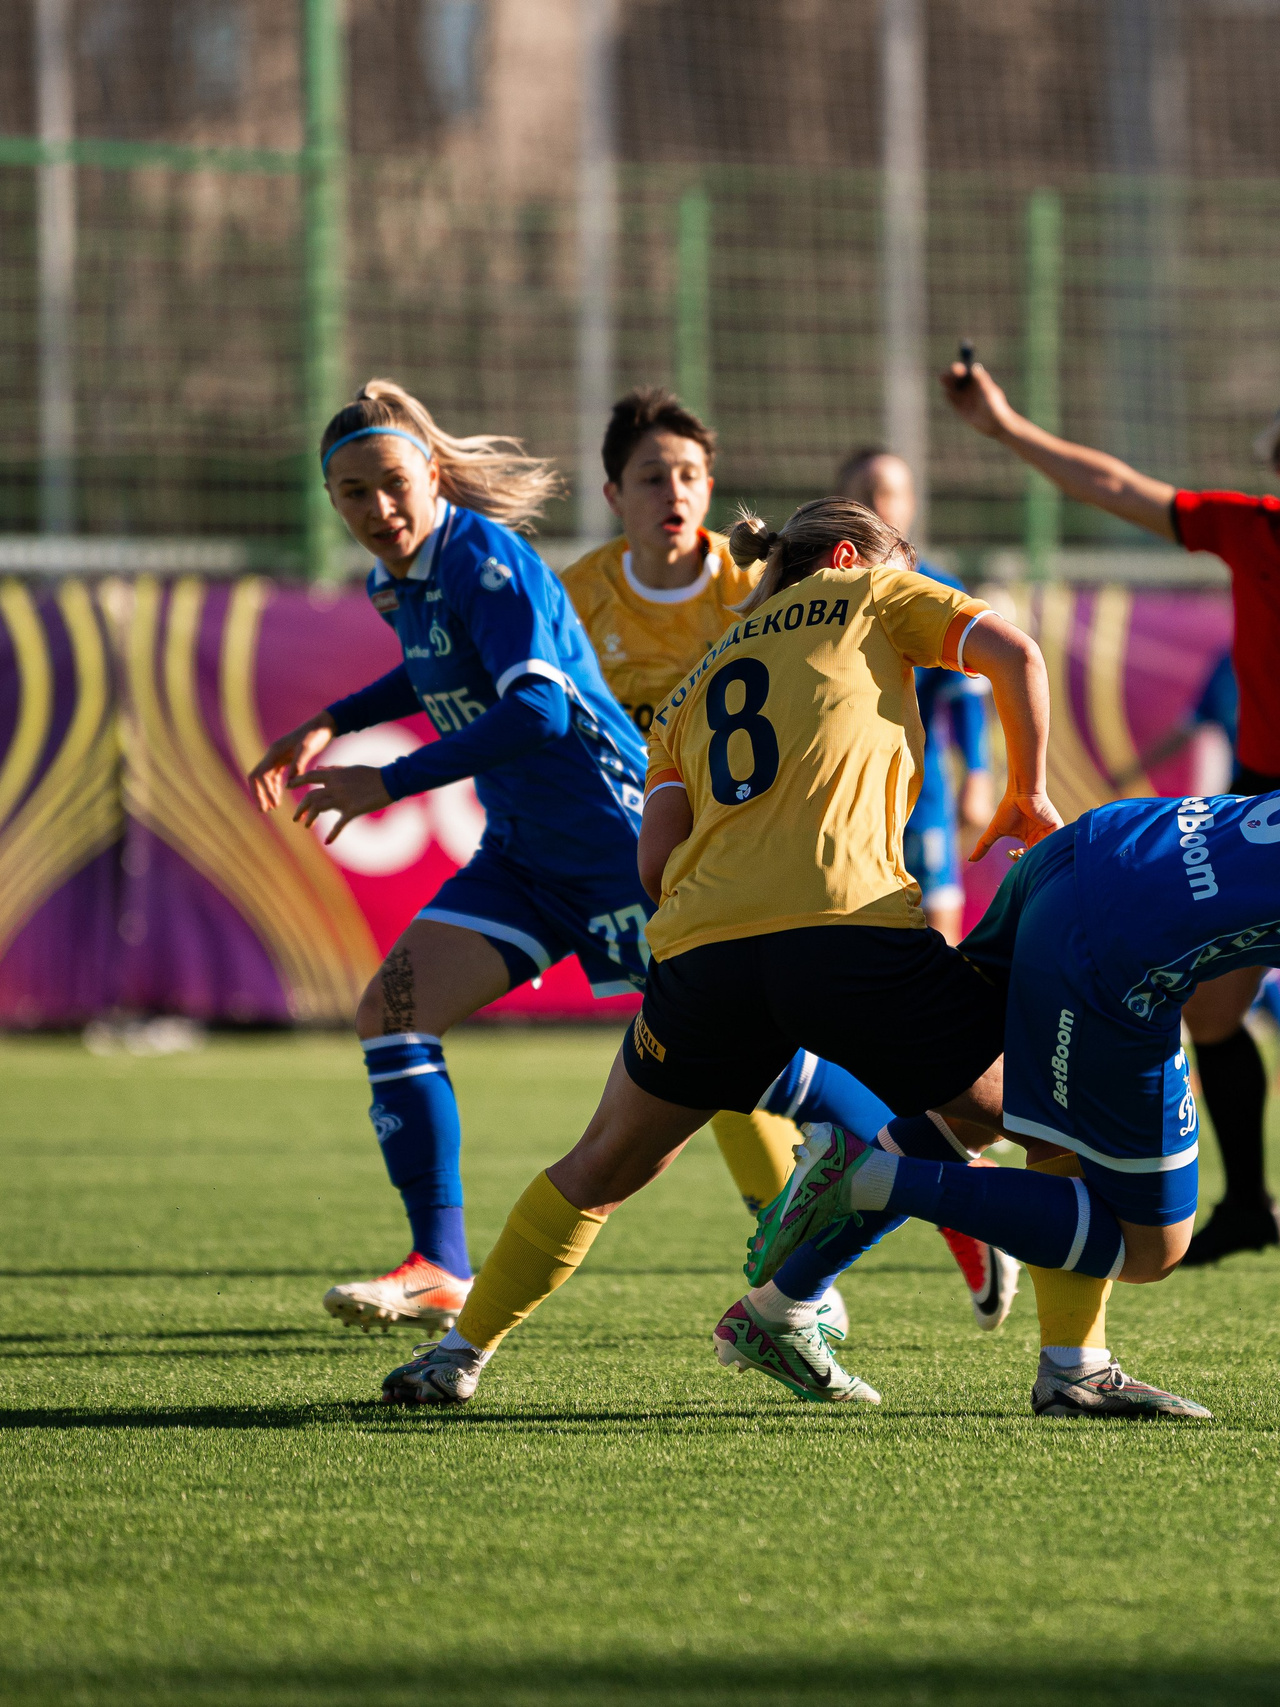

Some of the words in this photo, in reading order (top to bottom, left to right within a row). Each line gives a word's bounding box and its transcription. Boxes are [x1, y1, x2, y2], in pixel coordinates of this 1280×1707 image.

[706, 657, 779, 806] 8
[1177, 796, 1219, 901] etBoom
[1051, 1008, 1075, 1110] BetBoom
